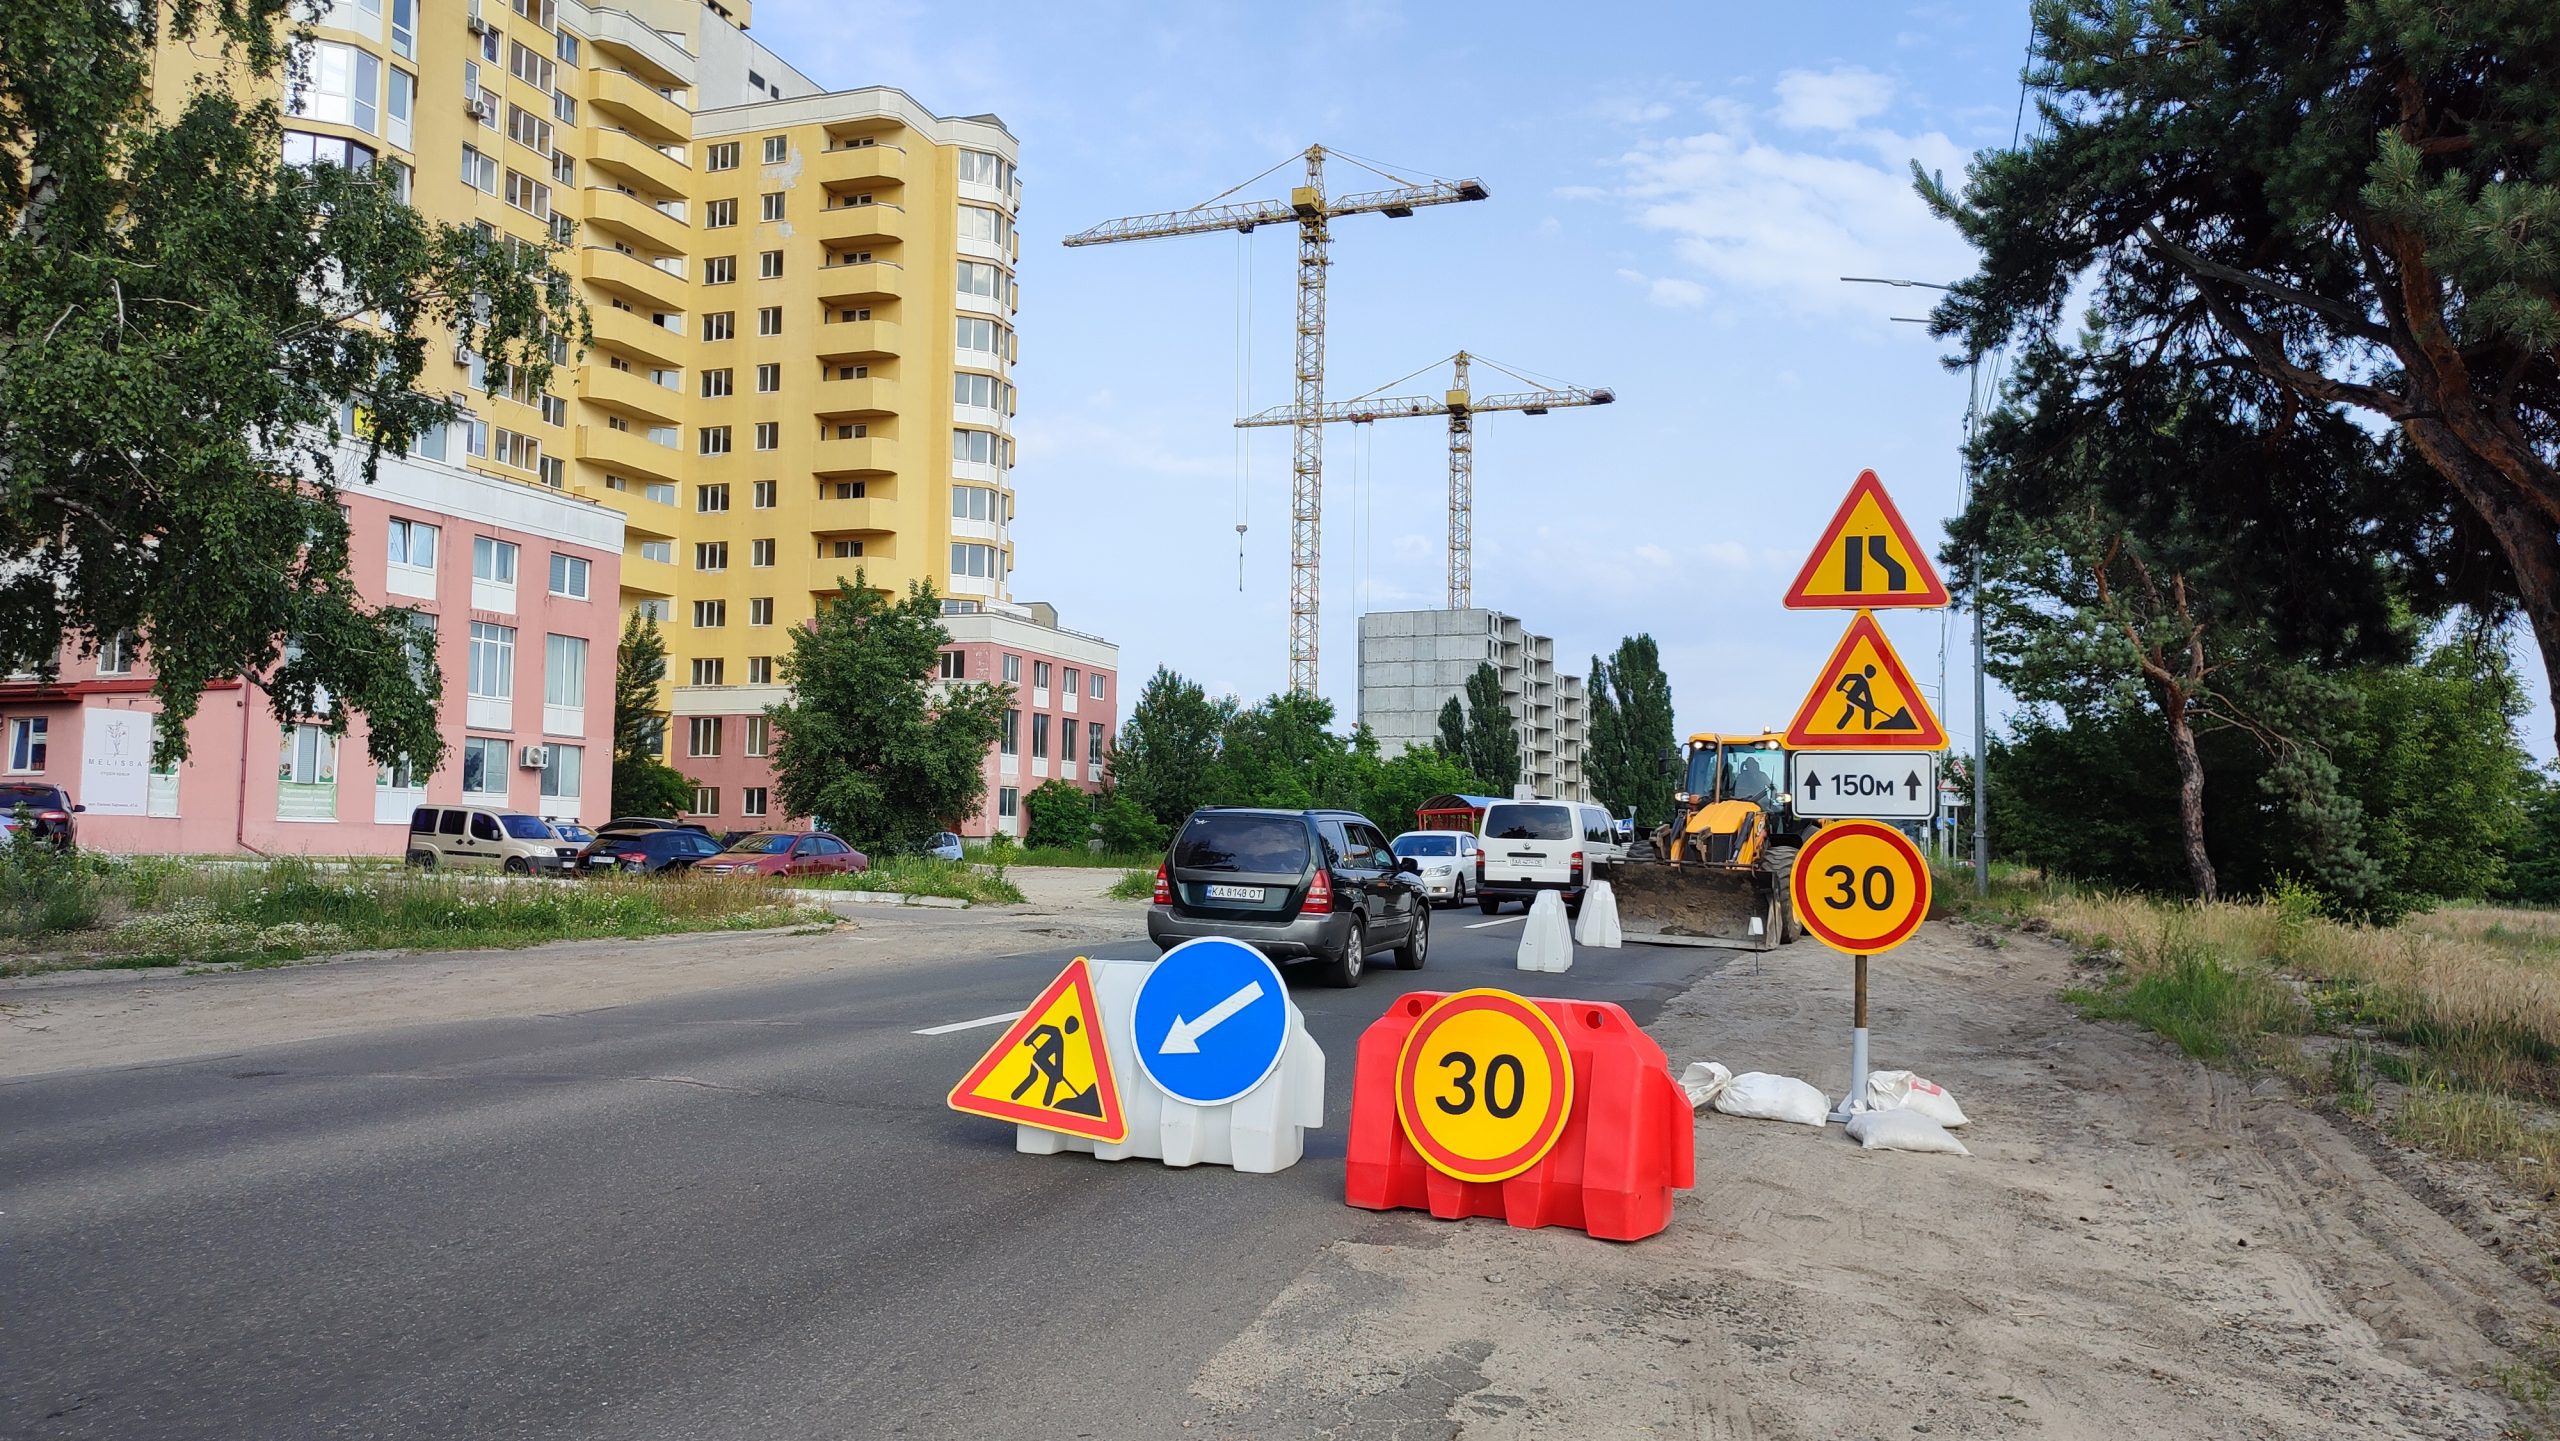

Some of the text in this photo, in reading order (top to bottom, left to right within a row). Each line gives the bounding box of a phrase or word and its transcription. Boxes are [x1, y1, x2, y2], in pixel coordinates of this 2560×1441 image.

[88, 758, 143, 767] MELISSA
[1830, 773, 1894, 796] 150м
[1211, 887, 1224, 897] KA
[1248, 889, 1263, 899] OT
[1824, 864, 1895, 911] 30
[1435, 1051, 1525, 1119] 30
